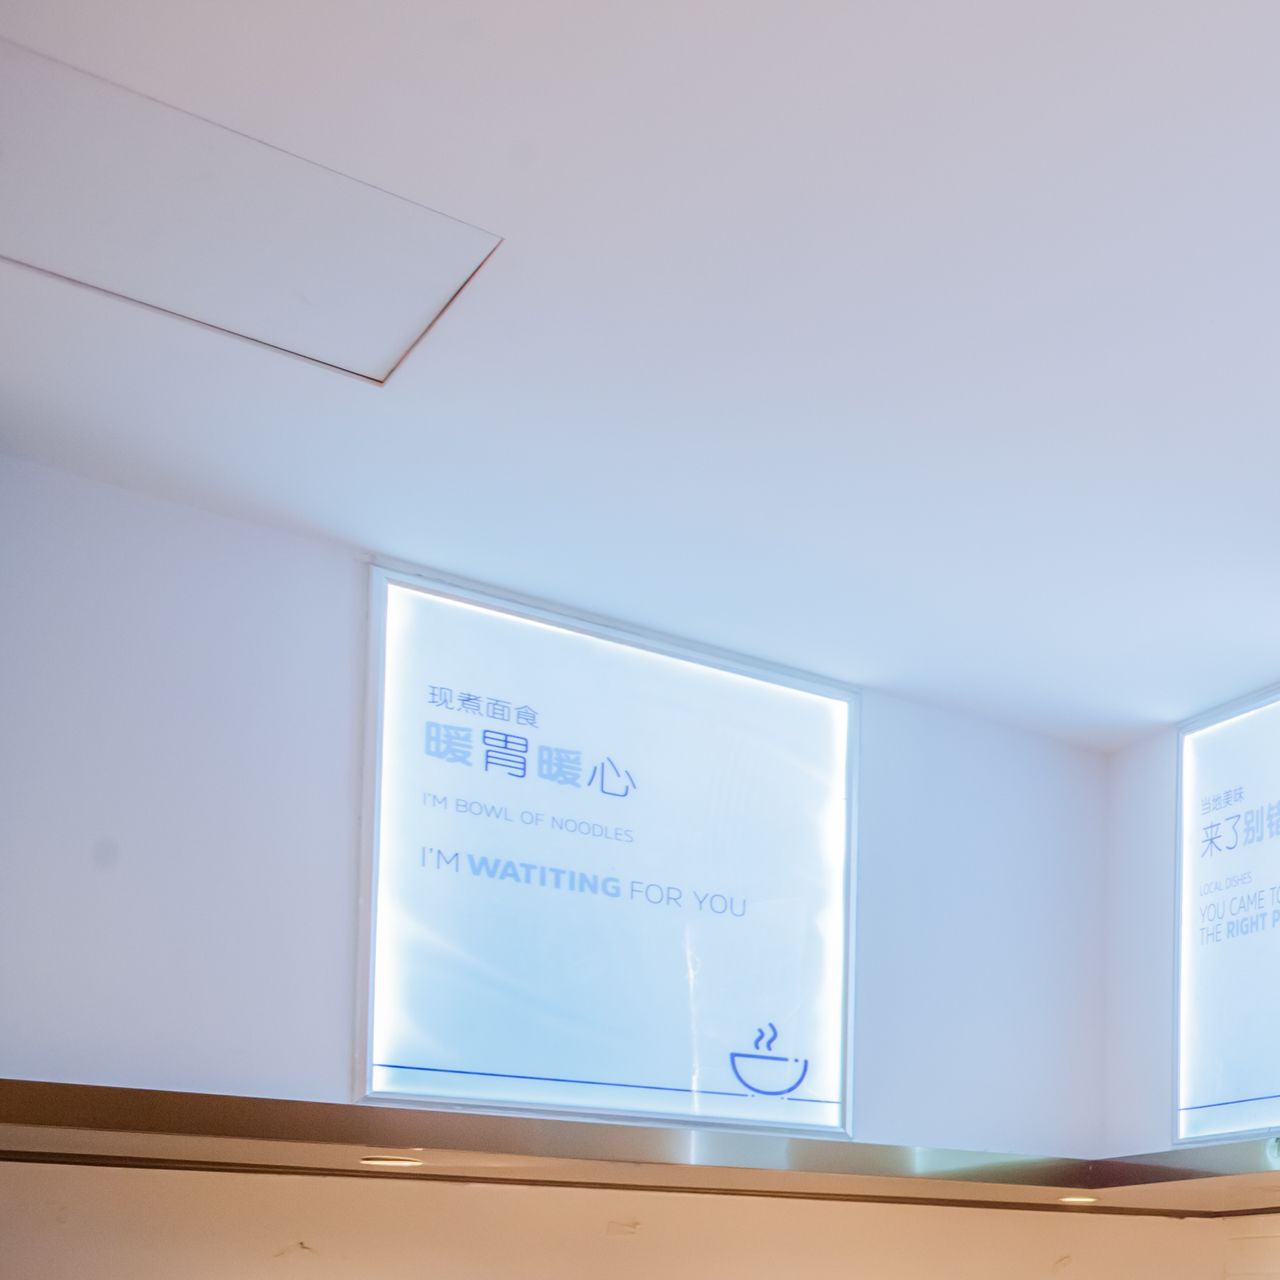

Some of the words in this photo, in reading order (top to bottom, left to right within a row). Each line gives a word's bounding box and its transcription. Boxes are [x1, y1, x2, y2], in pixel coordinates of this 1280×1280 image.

[427, 685, 539, 728] 现煮面食
[424, 721, 636, 797] 暖胃暖心
[422, 792, 447, 810] I'M
[455, 799, 513, 822] BOWL
[520, 811, 545, 826] OF
[551, 816, 634, 842] NOODLES
[421, 847, 459, 872] I'M
[467, 854, 622, 898] WATITING
[630, 881, 682, 908] FOR
[693, 890, 746, 917] YOU
[1199, 880, 1223, 897] LOCAL
[1225, 871, 1253, 890] DISHES
[1199, 901, 1225, 923] YOU
[1230, 890, 1265, 916] CAME
[1199, 924, 1222, 945] THE
[1226, 912, 1268, 939] RIGHT
